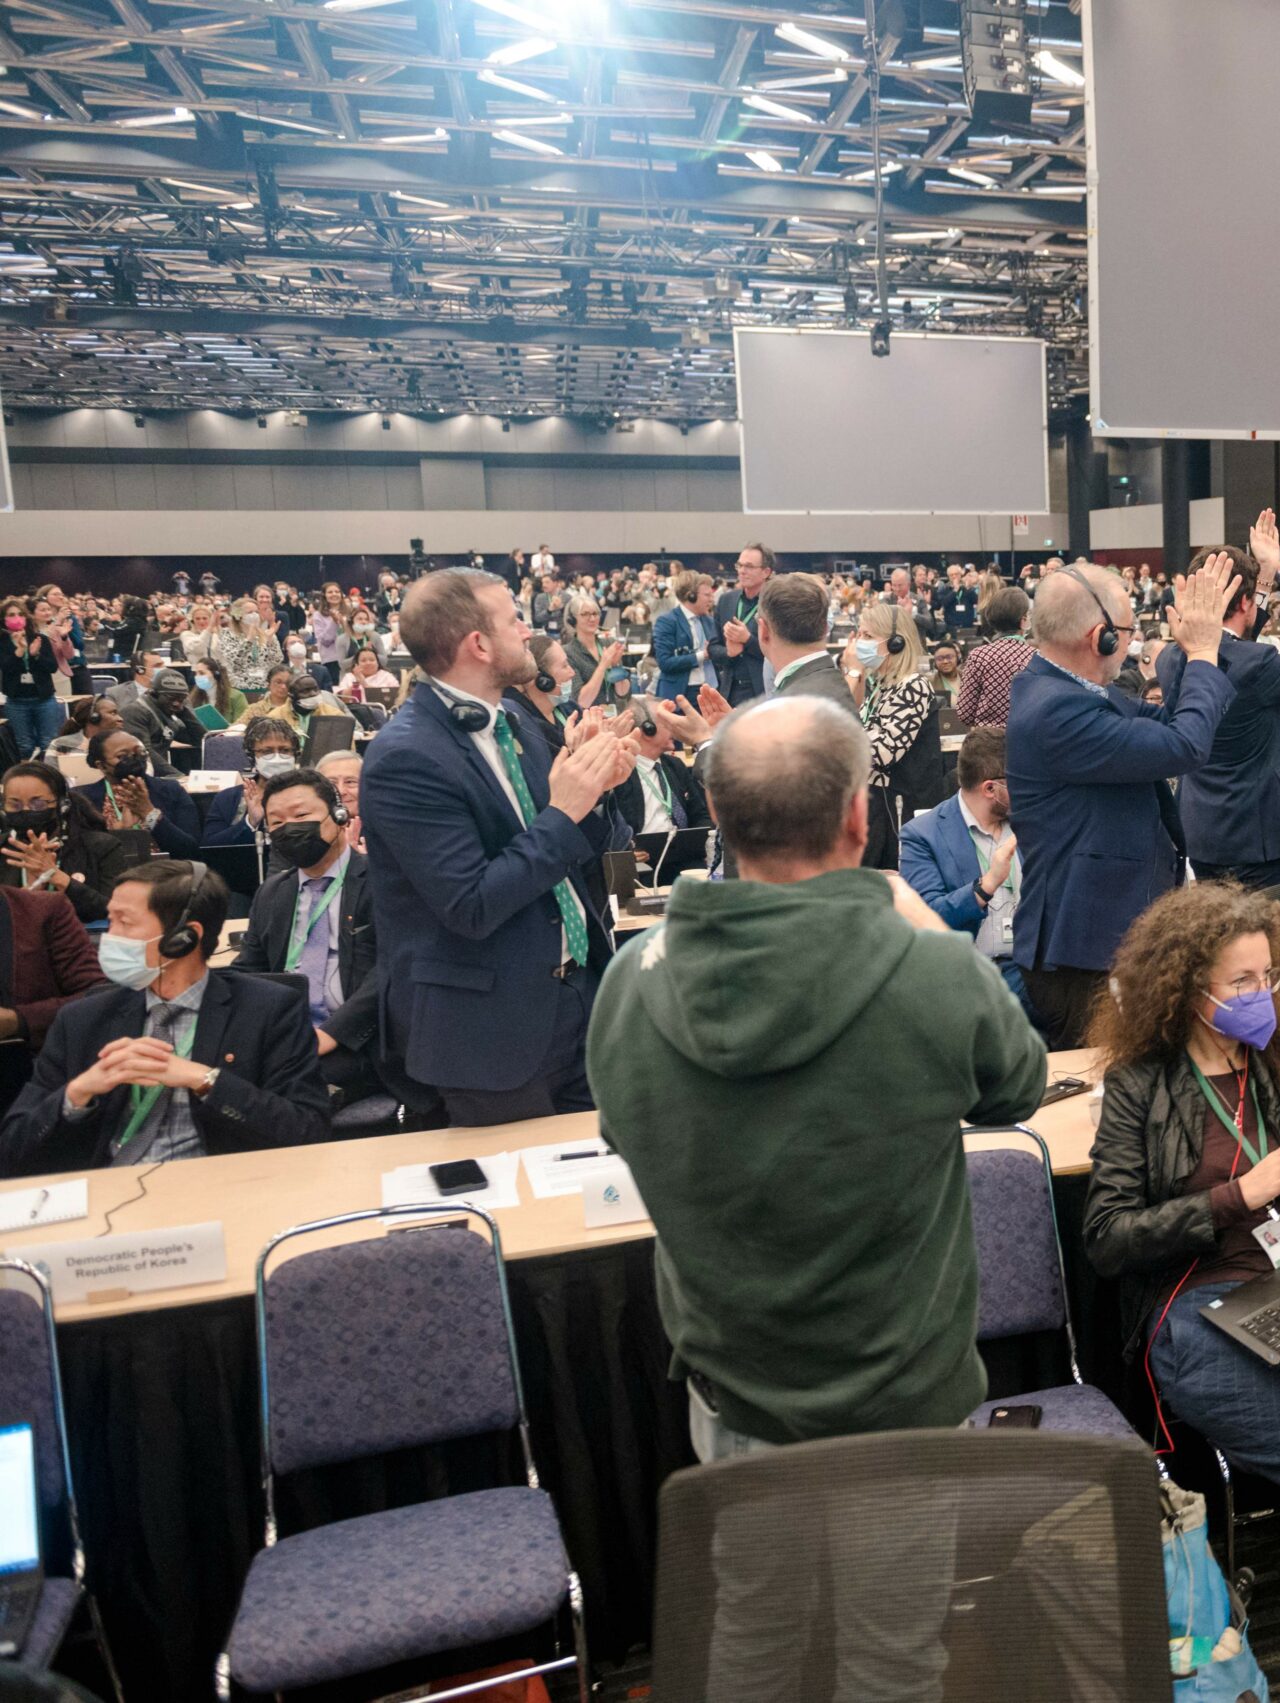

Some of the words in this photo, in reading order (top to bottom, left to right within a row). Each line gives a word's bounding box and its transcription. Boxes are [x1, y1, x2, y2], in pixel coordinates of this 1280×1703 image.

[66, 1250, 137, 1267] Democratic
[140, 1242, 194, 1257] People's
[75, 1263, 131, 1278] Republic
[134, 1260, 147, 1270] of
[150, 1257, 188, 1269] Korea
